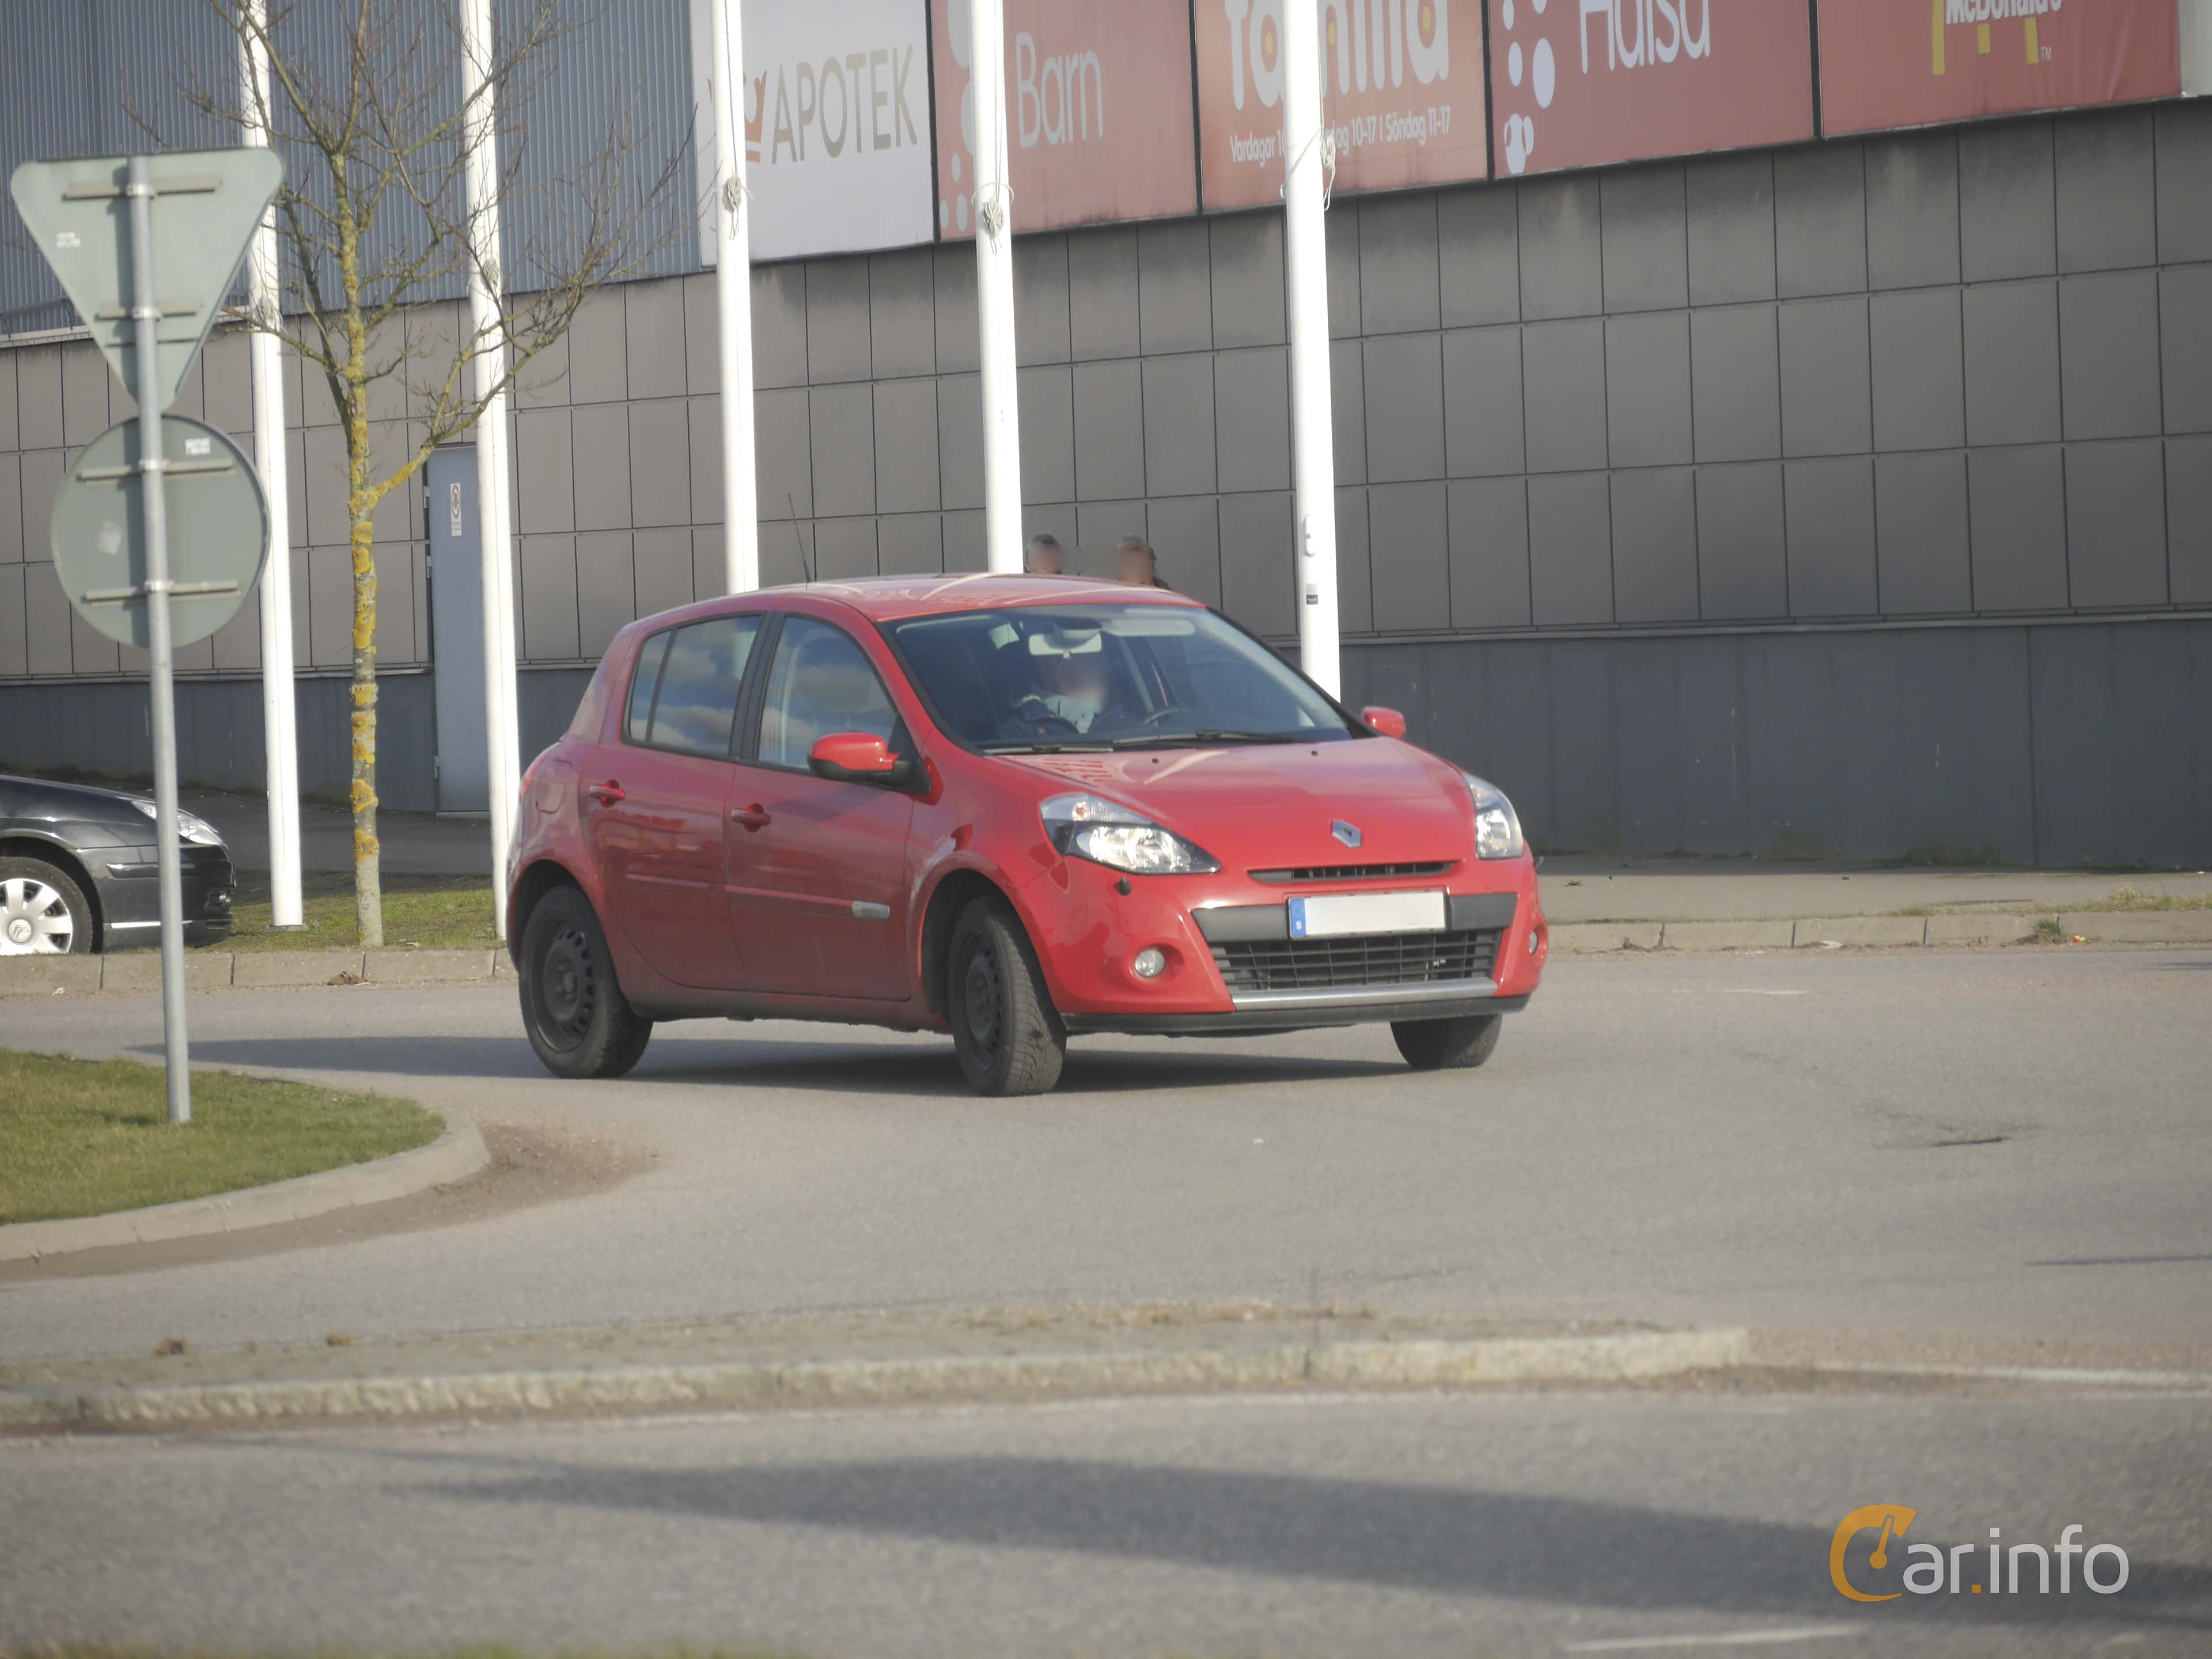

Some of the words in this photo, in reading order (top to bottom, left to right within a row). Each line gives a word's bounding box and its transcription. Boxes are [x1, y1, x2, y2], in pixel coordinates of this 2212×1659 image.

[1016, 32, 1104, 148] Barn
[2041, 46, 2052, 60] TM
[771, 44, 917, 164] APOTEK
[1230, 131, 1275, 168] Vardagar
[1351, 116, 1376, 146] 10-17
[1386, 109, 1426, 146] Söndag
[1427, 105, 1450, 136] 11-17
